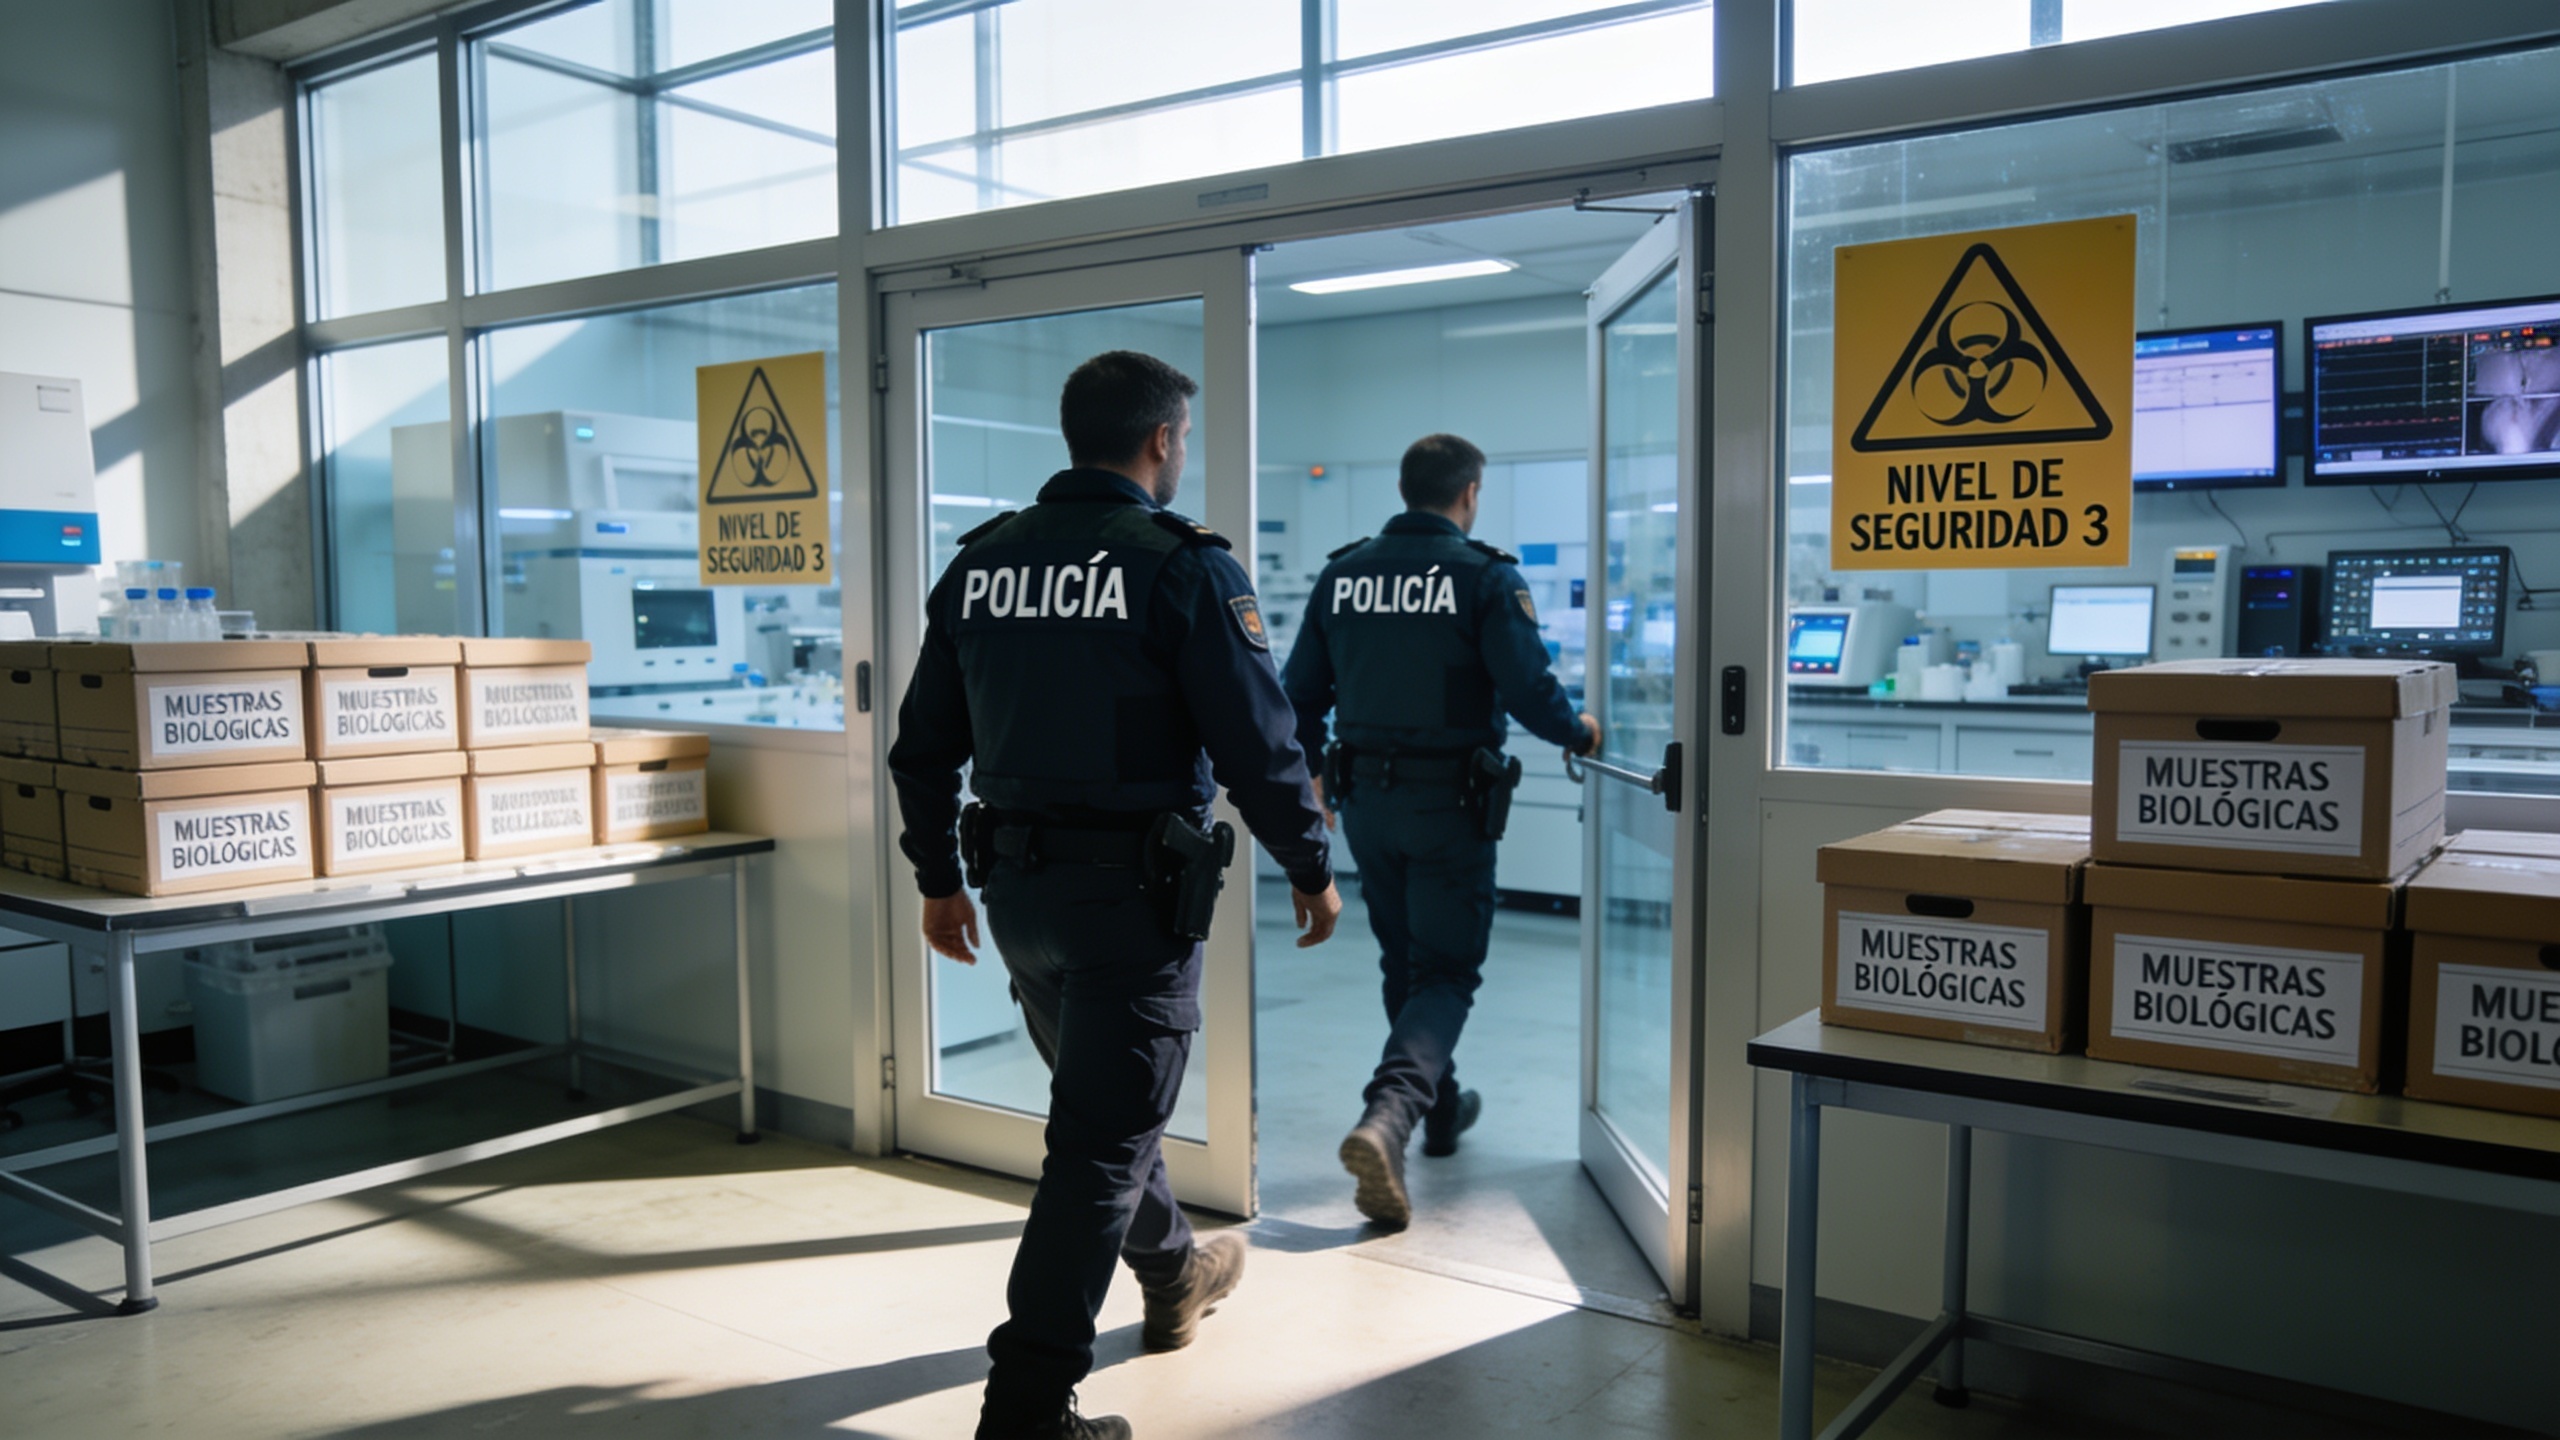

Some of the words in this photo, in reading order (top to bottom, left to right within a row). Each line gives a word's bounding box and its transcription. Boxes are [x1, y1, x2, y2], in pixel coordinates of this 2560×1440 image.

[1887, 461, 1997, 505] NIVEL
[2012, 458, 2064, 500] DE
[718, 511, 770, 542] NIVEL
[776, 511, 802, 538] DE
[1850, 507, 2069, 552] SEGURIDAD
[2082, 503, 2109, 547] 3
[707, 544, 806, 574] SEGURIDAD
[812, 543, 825, 572] 3
[961, 550, 1128, 620] POLICÍA
[1331, 564, 1457, 615] POLICÍA
[165, 690, 283, 719] MUESTRAS
[2145, 757, 2330, 791] MUESTRAS
[174, 810, 291, 842] MUESTRAS
[2138, 791, 2340, 832] BIOLÓGICAS
[1862, 928, 2018, 970] MUESTRAS
[1855, 962, 2026, 1008] BIOLÓGICAS
[2142, 953, 2326, 998] MUESTRAS
[2134, 989, 2336, 1040] BIOLÓGICAS
